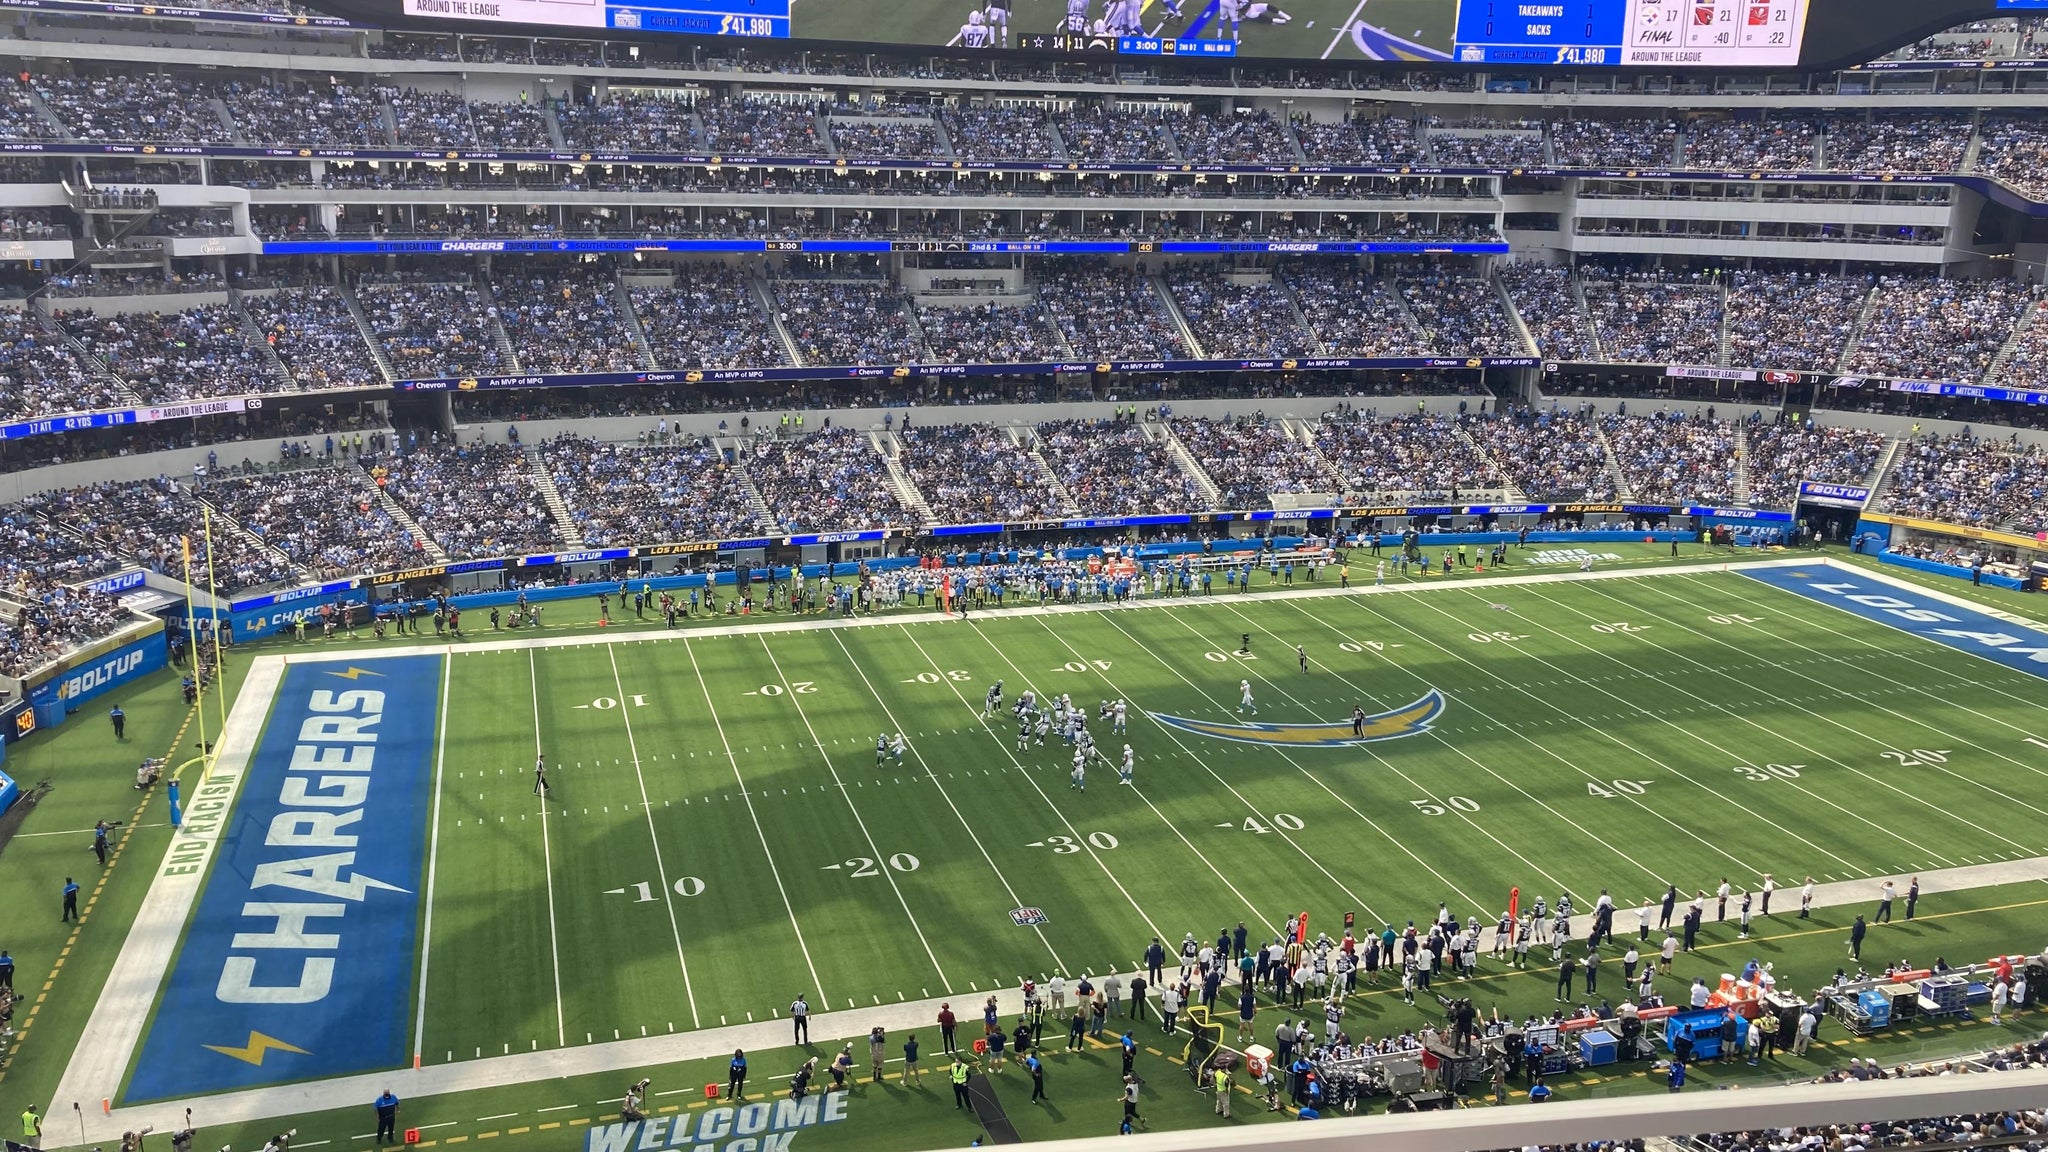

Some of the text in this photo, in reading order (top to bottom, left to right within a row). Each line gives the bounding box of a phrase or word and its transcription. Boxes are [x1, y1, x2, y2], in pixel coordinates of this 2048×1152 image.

[417, 0, 500, 16] AROUND THE LEAGUE
[1488, 2, 1493, 17] 1
[1518, 5, 1563, 16] TAKEAWAYS
[1587, 4, 1593, 18] 1
[1667, 10, 1677, 21] 17
[1720, 10, 1731, 21] 21
[1775, 10, 1786, 21] 21
[651, 15, 679, 27] CURRENT
[682, 17, 710, 29] JACKPOT
[1527, 24, 1551, 35] SACKS
[968, 34, 983, 46] 87
[1053, 36, 1063, 48] 14
[1074, 37, 1083, 49] 11
[1639, 30, 1673, 44] FINAL
[1715, 32, 1729, 44] :40
[1769, 32, 1784, 44] :22
[1136, 41, 1157, 51] 3:00
[1164, 42, 1173, 50] 40
[1493, 50, 1519, 59] CURRENT
[1521, 51, 1547, 60] JACKPOT
[1631, 51, 1702, 62] AROUND THE LEAGUE
[442, 242, 505, 251] CHARGERS
[918, 243, 925, 251] 14
[935, 243, 942, 251] 11
[648, 373, 675, 381] Chevron
[859, 368, 883, 376] Chevron
[1687, 369, 1742, 379] AROUND THE LEAGUE
[416, 381, 446, 389] Chevron
[1811, 375, 1819, 383] 17
[1899, 382, 1931, 392] FINAL
[1956, 386, 1985, 397] MITCHELL
[2006, 391, 2014, 400] 17
[2015, 392, 2027, 401] ATT
[2038, 394, 2047, 403] 42
[163, 402, 228, 418] AROUND THE LEAGUE
[30, 413, 124, 434] 17 ATT 42 YDS 0 TD
[1806, 484, 1867, 498] #BOLTUP
[1274, 511, 1312, 519] #BOLTUP
[1408, 507, 1451, 515] CHARGERS
[1714, 510, 1757, 518] #BOLTUP
[817, 533, 859, 543] #BOLTUP
[650, 539, 771, 554] LOS ANGELES CHARGERS
[554, 552, 602, 564] #BOLTUP
[373, 560, 503, 584] LOS ANGELES CHARGERS
[274, 586, 322, 603] #BOLTUP
[1807, 583, 1964, 622] LOS
[247, 617, 266, 633] LA
[1707, 613, 1757, 625] 10
[1590, 622, 1643, 633] 20
[1467, 631, 1520, 643] 30
[1338, 640, 1384, 653] 40
[1204, 649, 1258, 662] 50
[1064, 659, 1113, 673] 40
[57, 649, 143, 699] #BOLTUP
[917, 669, 971, 684] 30
[760, 682, 818, 697] 20
[592, 693, 651, 710] 10
[17, 709, 32, 729] 40
[1880, 749, 1947, 766] 20
[1733, 763, 1800, 781] 30
[1586, 779, 1646, 798] 40
[1409, 796, 1481, 816] 50
[164, 774, 236, 877] END RACISM
[1242, 813, 1305, 835] 40
[215, 689, 413, 1004] CHARGERS
[1048, 831, 1119, 854] 30
[845, 852, 920, 878] 20
[631, 876, 705, 903] 10
[1014, 909, 1042, 918] NFL
[1736, 1004, 1746, 1015] G
[976, 1041, 985, 1051] 20
[707, 1086, 716, 1096] 10
[587, 1090, 850, 1152] WELCOME
[408, 1131, 415, 1141] G
